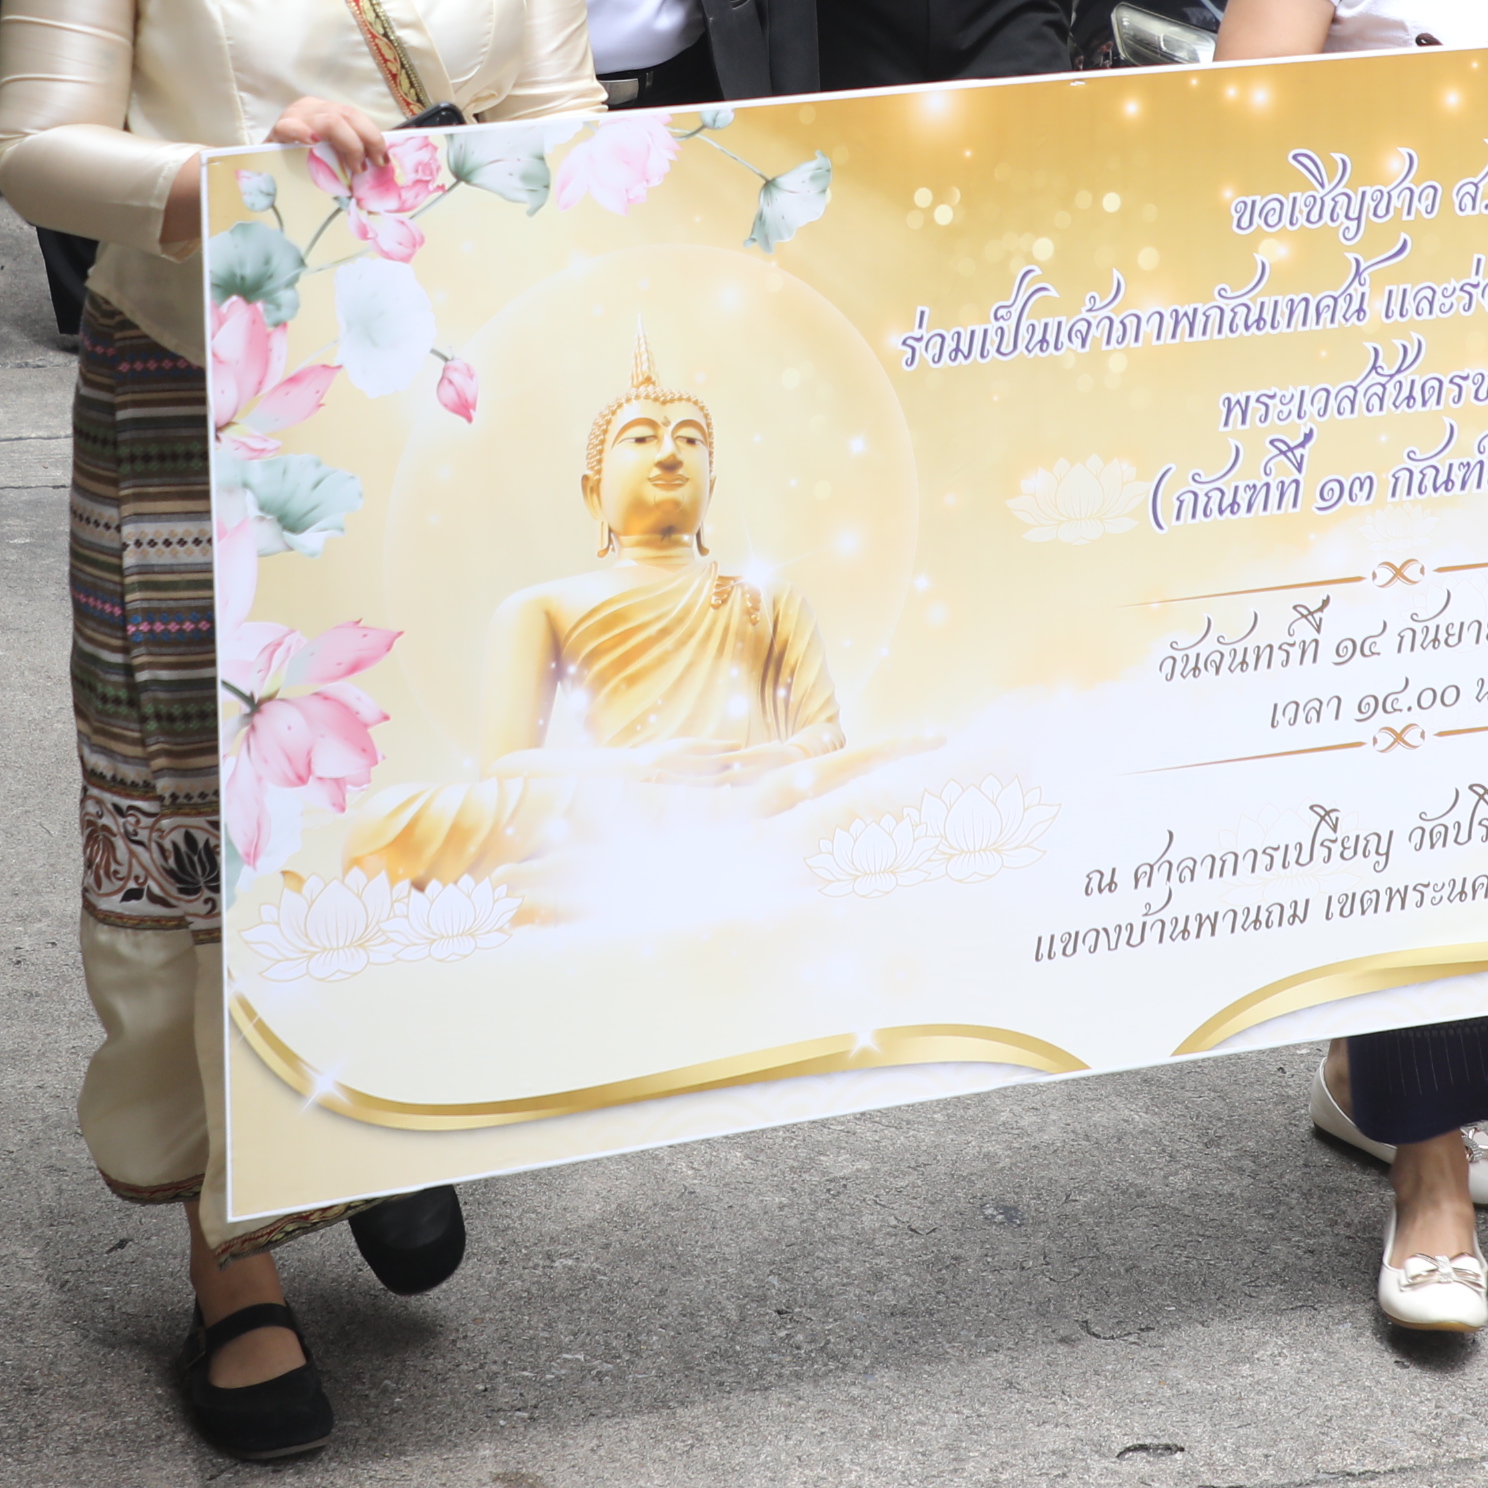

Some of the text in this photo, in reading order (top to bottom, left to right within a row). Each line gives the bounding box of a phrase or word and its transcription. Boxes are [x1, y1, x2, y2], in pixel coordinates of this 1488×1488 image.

[1232, 147, 1442, 244] ขอเชิญชาว
[1314, 473, 1375, 513] ๑๓
[1159, 594, 1331, 682] วันจันทร์ที่
[1331, 619, 1387, 666] ๑๔
[1270, 695, 1342, 729] เวลา
[1084, 866, 1119, 897] ณ
[1133, 803, 1394, 891] ศาลาการเปรียญ
[1034, 885, 1310, 962] แขวงบ้านพานถม
